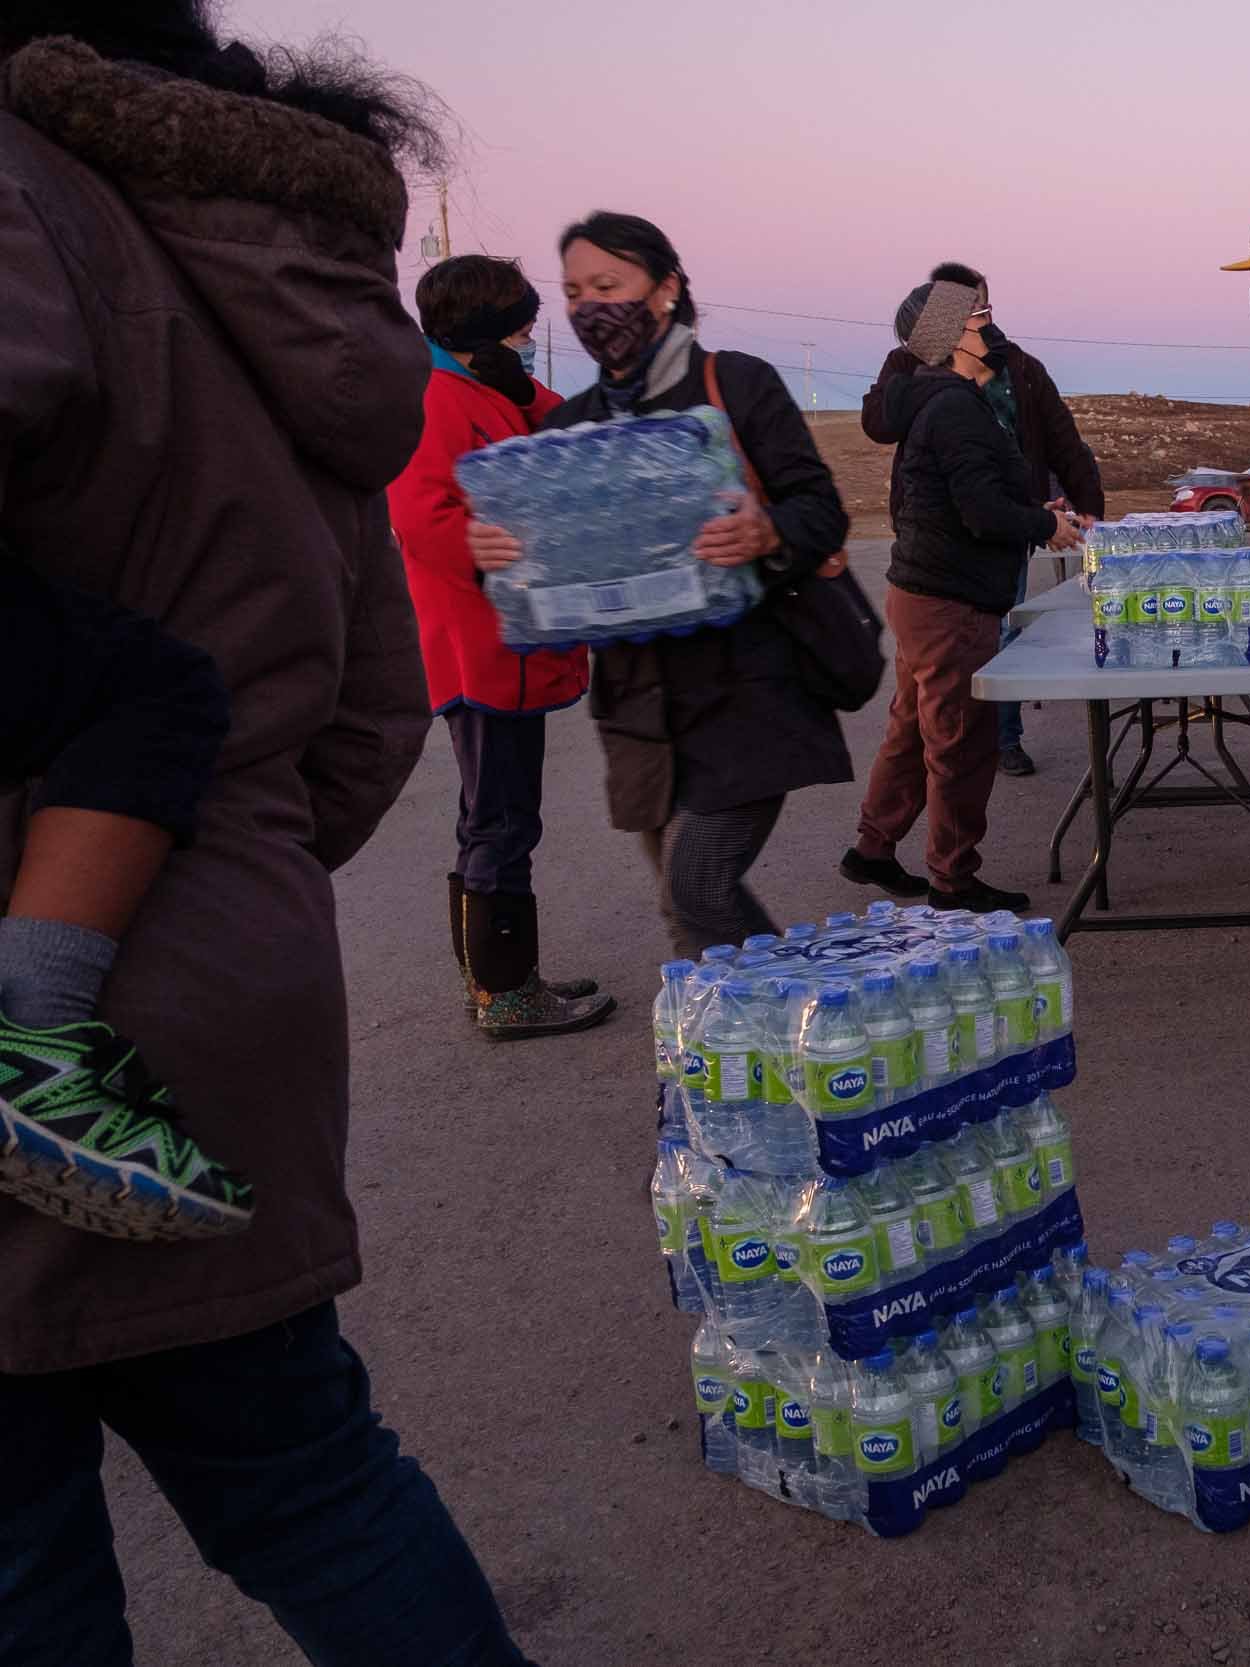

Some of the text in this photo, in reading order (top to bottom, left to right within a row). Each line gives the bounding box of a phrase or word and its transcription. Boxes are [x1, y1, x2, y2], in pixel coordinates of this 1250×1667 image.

[832, 1077, 865, 1091] NAYA
[863, 1116, 916, 1150] NAYA
[735, 1246, 767, 1260] NAYA
[827, 1259, 860, 1273] NAYA
[872, 1291, 926, 1328] NAYA
[863, 1442, 896, 1454] NAYA
[912, 1465, 961, 1509] NAYA
